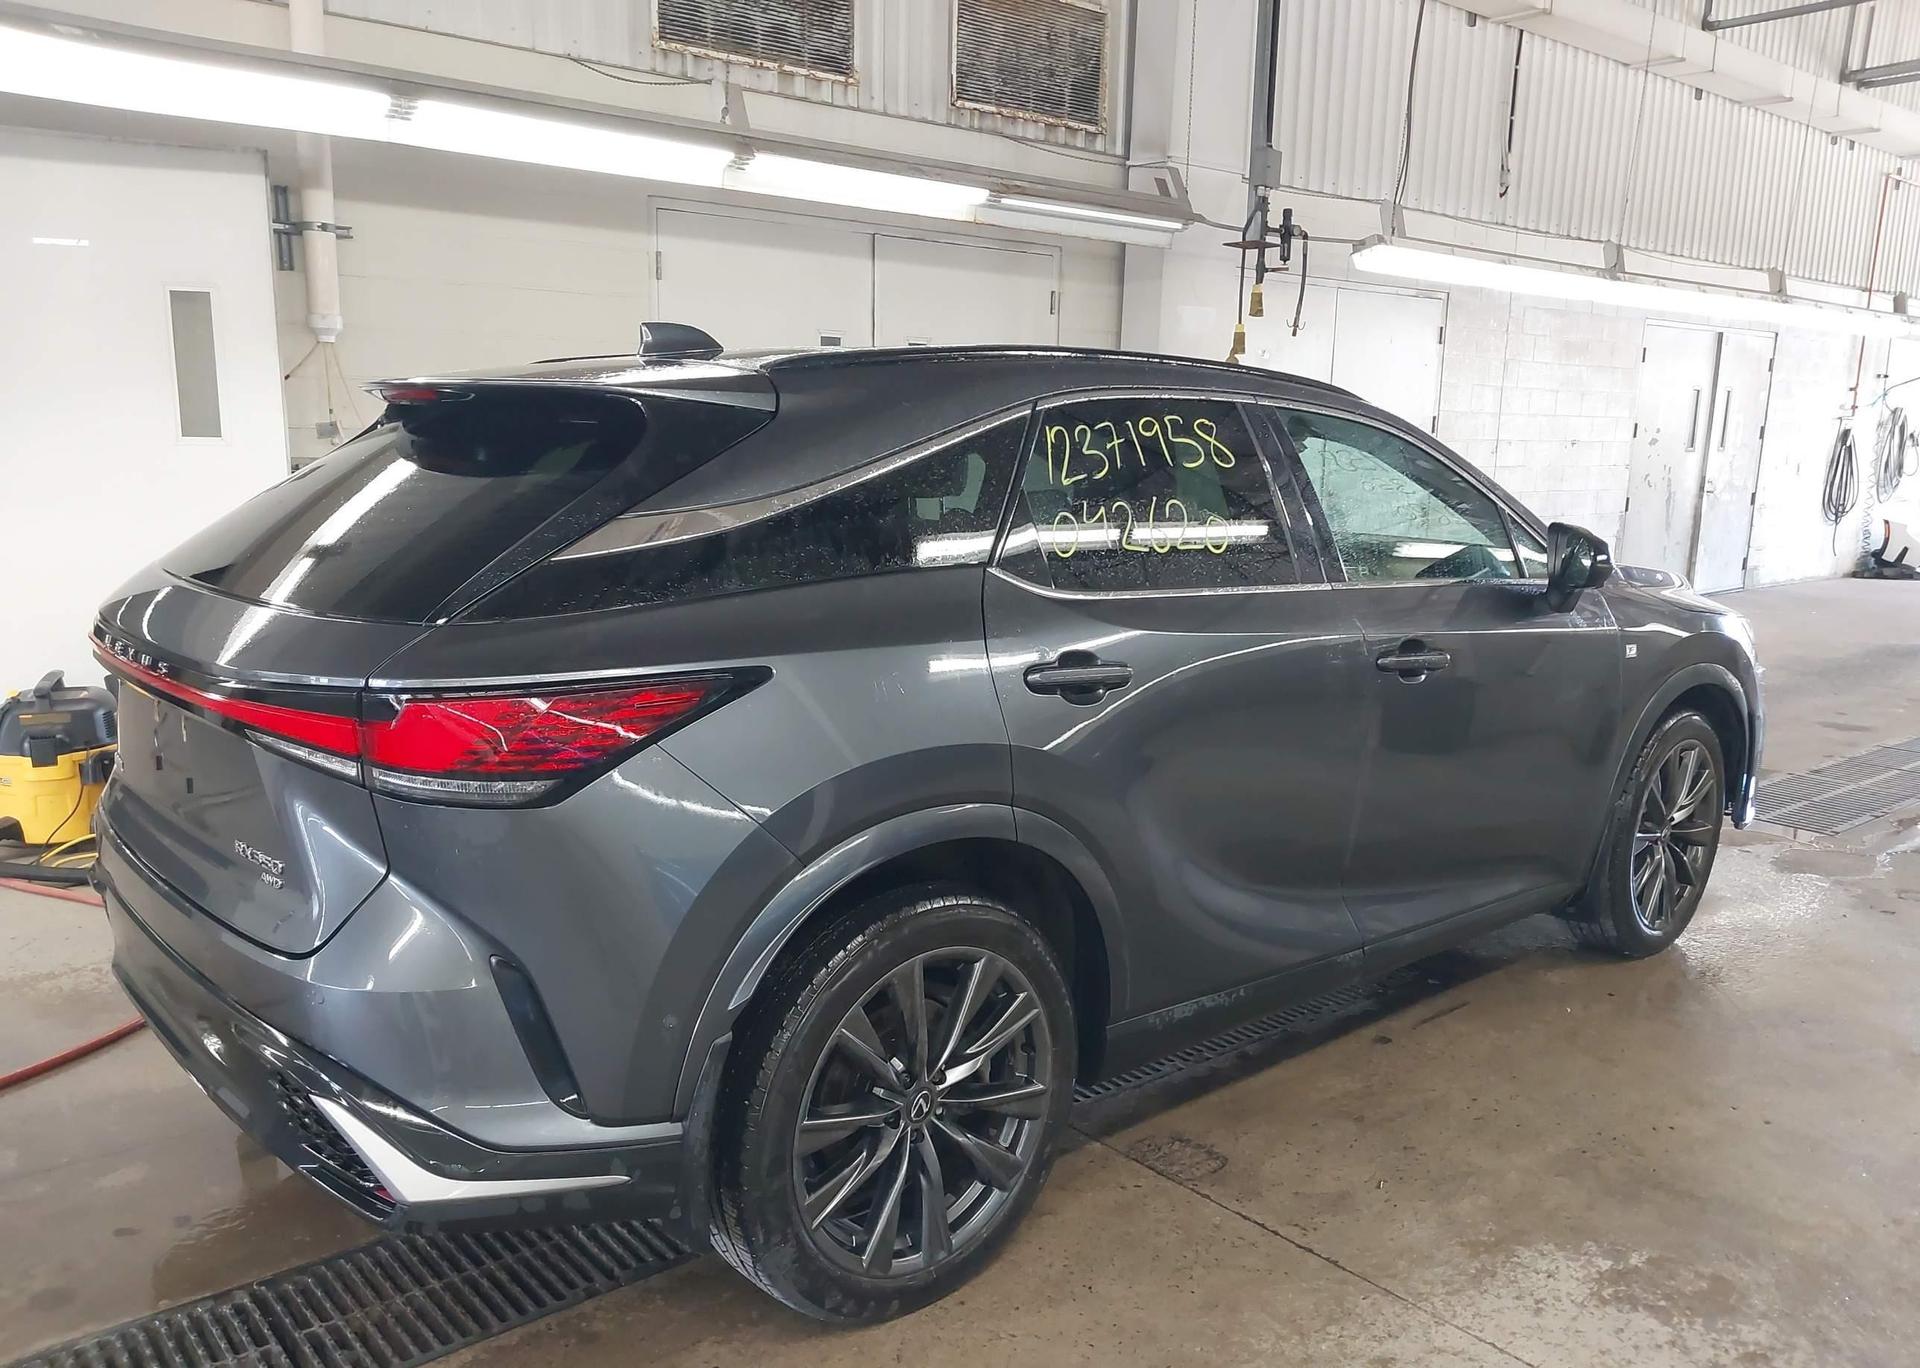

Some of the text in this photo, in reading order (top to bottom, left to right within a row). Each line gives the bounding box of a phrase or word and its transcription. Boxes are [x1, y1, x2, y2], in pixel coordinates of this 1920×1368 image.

[1045, 415, 1235, 485] 12371958
[1053, 496, 1229, 557] 042620
[104, 634, 169, 674] LEXUS
